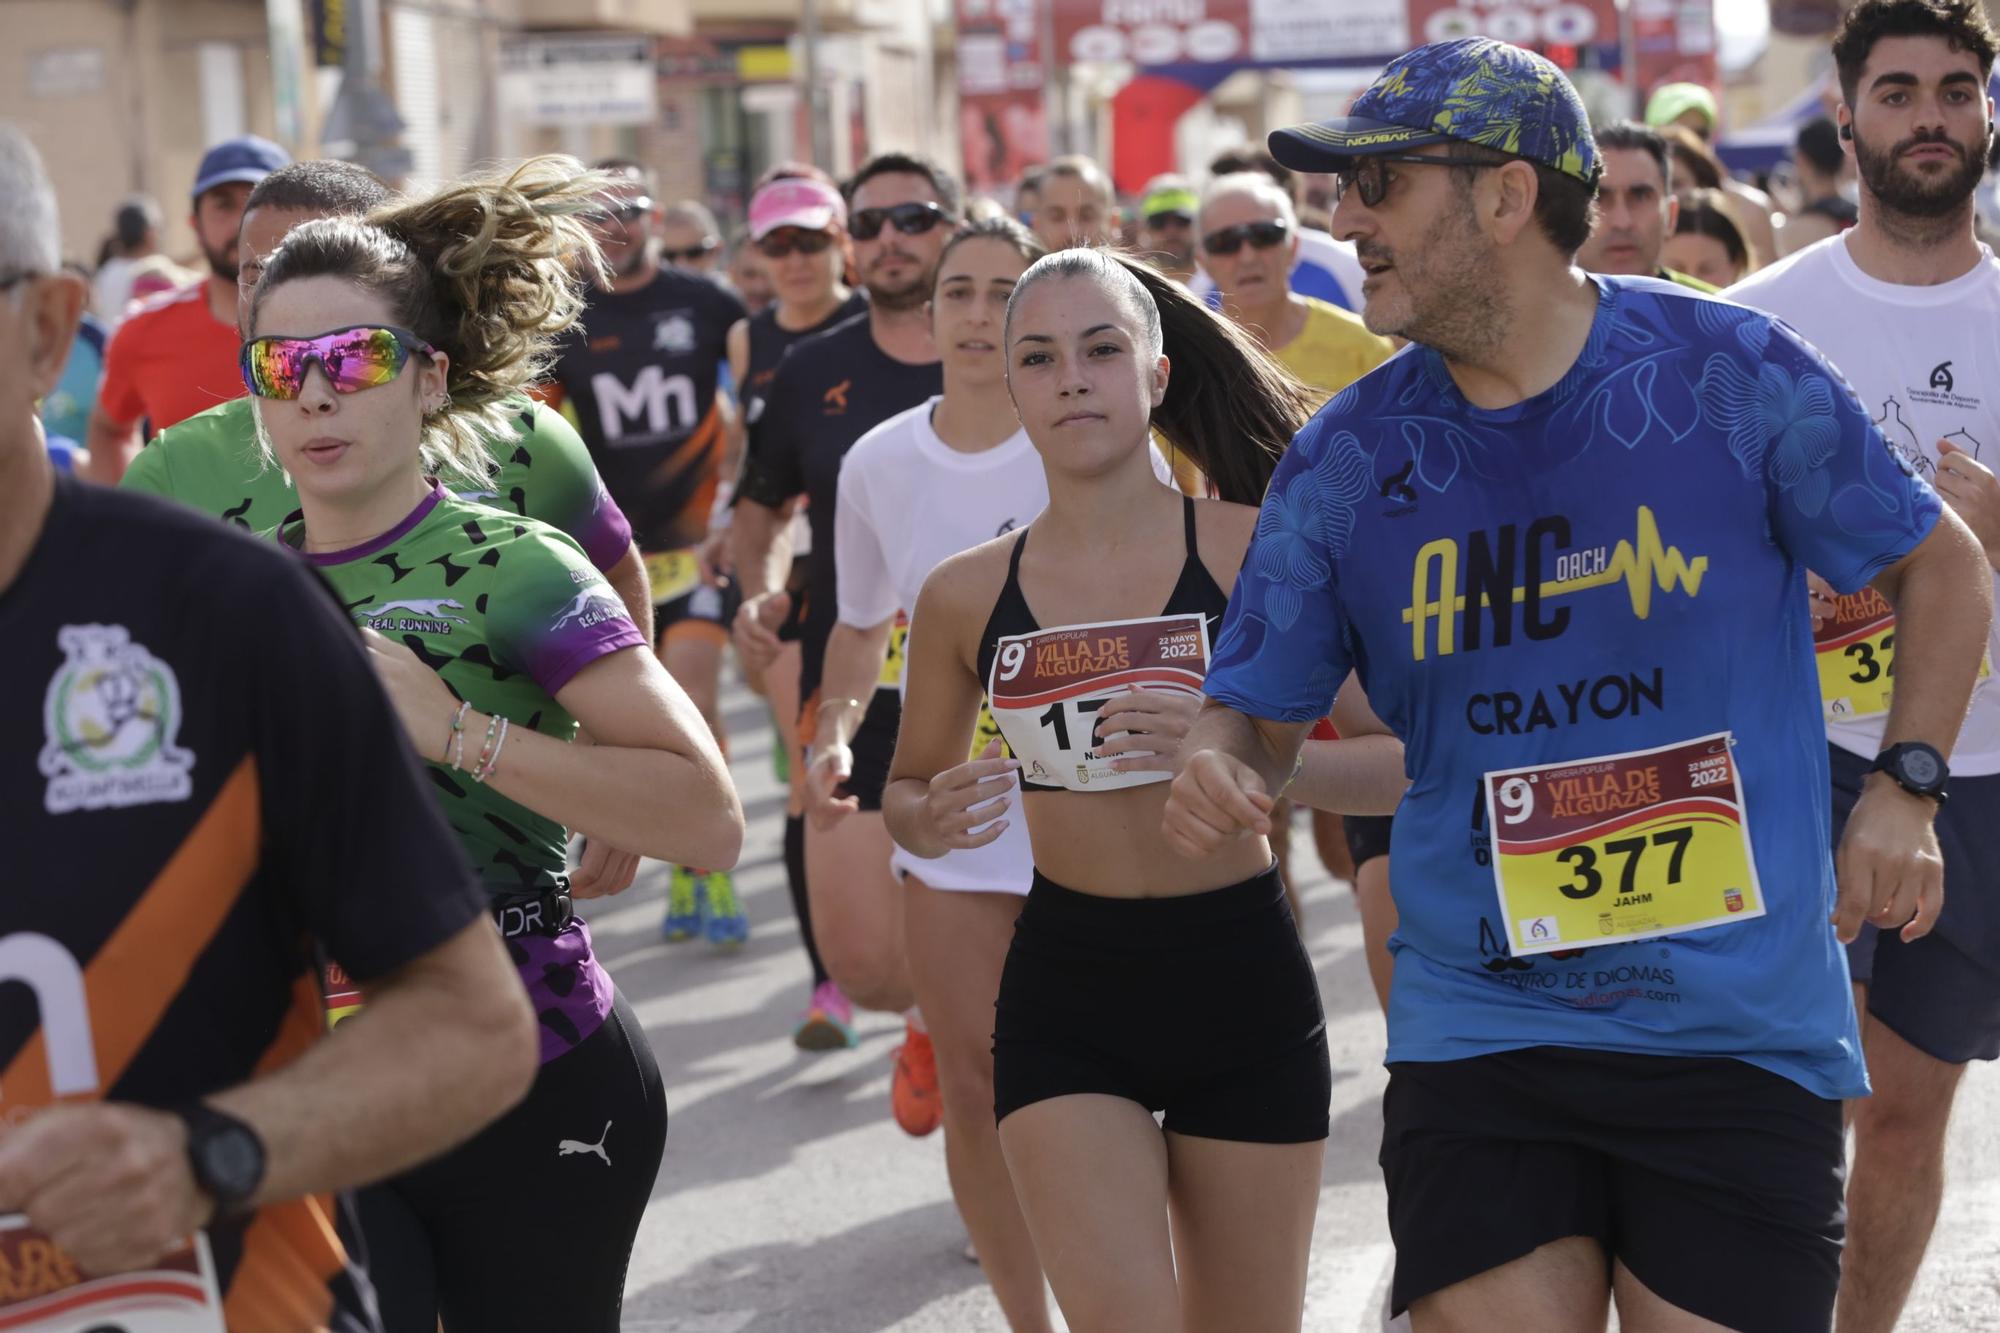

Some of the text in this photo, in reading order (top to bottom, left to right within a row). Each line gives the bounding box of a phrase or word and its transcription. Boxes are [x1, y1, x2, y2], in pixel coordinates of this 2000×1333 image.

[591, 365, 697, 440] Mn
[578, 608, 607, 629] REAL
[1835, 600, 1893, 625] ALGUA
[366, 618, 451, 635] REAL RUNNING
[1057, 630, 1089, 641] POPULAR
[1036, 636, 1129, 664] VILLA DE
[1158, 634, 1197, 646] 22 MAYO
[1160, 643, 1198, 660] 2022
[1034, 654, 1131, 678] ALGUAZAS
[1466, 667, 1663, 735] CRAYON
[1544, 762, 1616, 782] CARRERA POPULAR
[1688, 756, 1727, 773] 22 MAYO
[1547, 766, 1660, 802] VILLA DE
[1690, 766, 1729, 788] 2022
[1551, 786, 1663, 819] ALGUAZAS
[1556, 826, 1693, 900] 377
[1613, 893, 1653, 908] JAHM
[1565, 971, 1587, 989] DE
